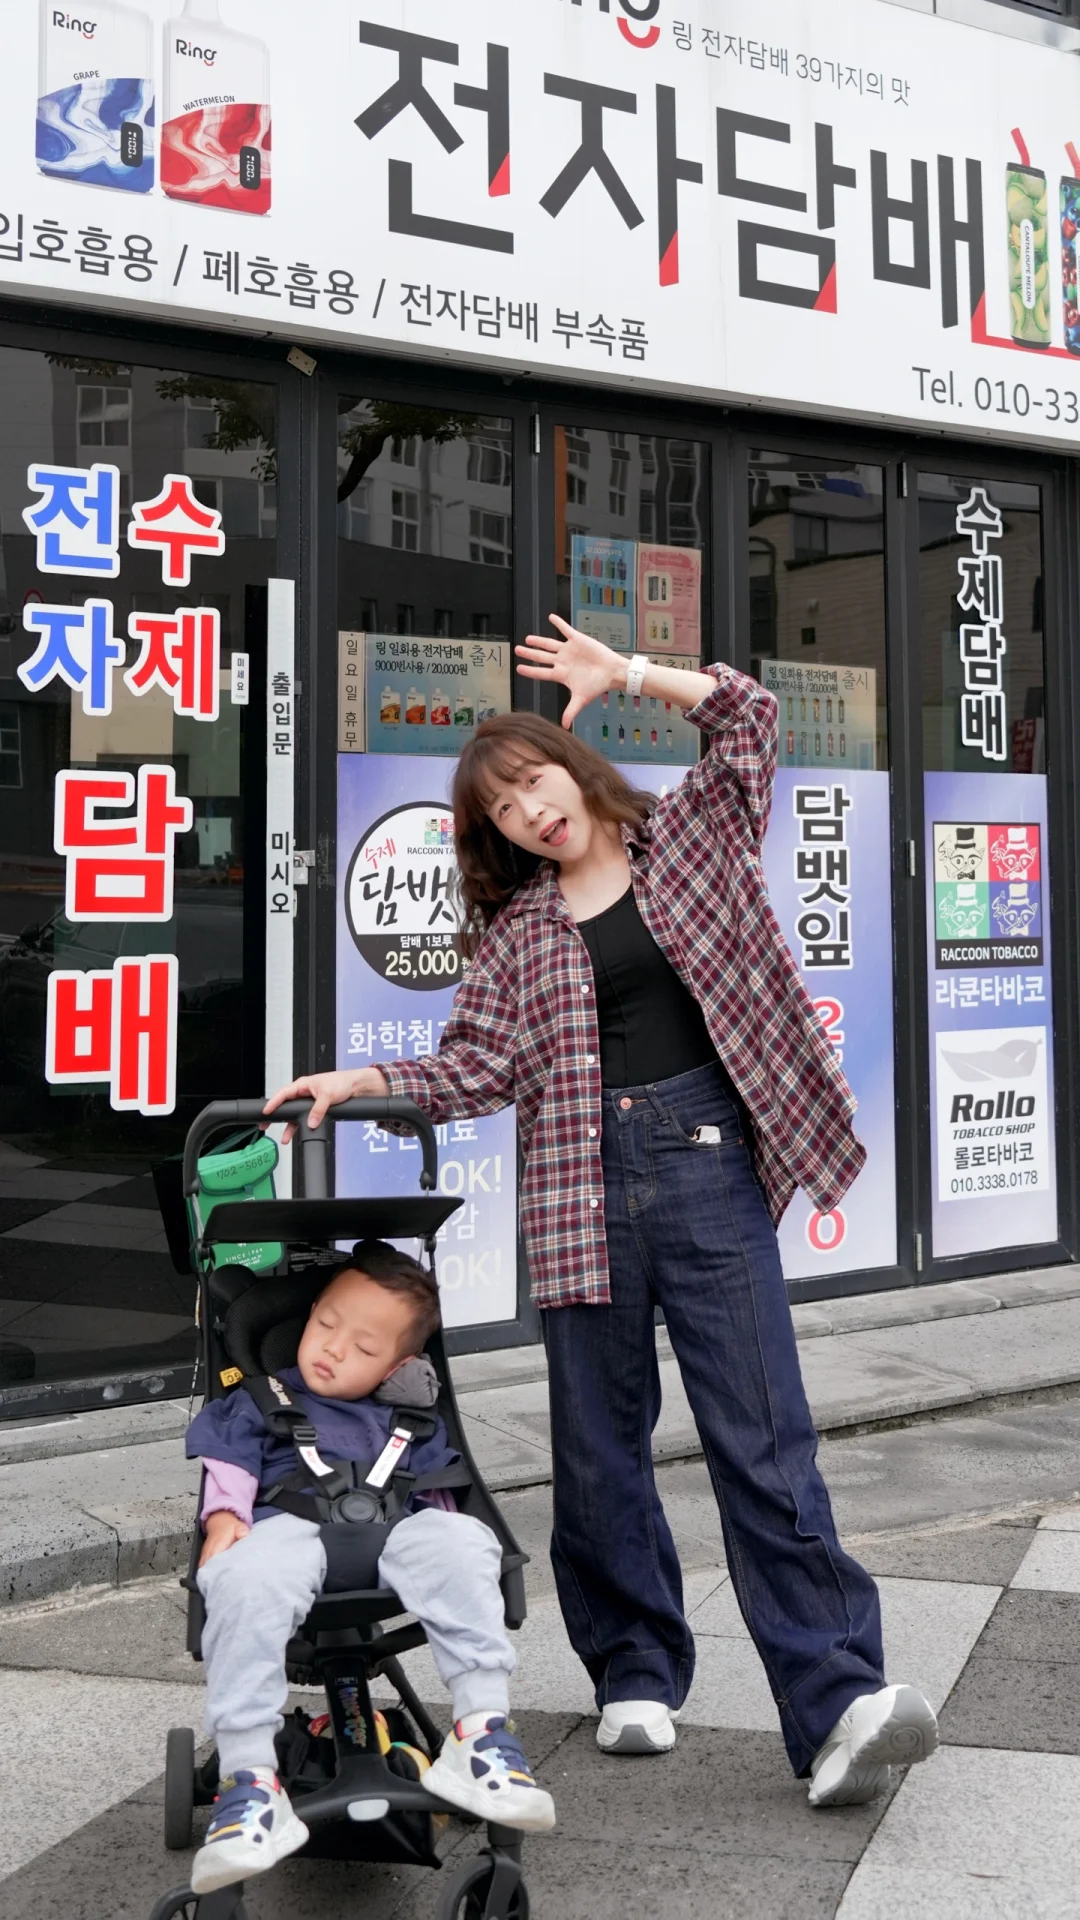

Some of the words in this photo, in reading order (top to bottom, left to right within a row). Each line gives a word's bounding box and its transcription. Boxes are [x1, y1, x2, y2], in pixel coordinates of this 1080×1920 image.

[53, 10, 97, 39] Ring
[176, 38, 217, 67] Ring
[673, 21, 692, 51] 링
[701, 28, 788, 76] 전자담배
[796, 54, 883, 100] 39가지의
[892, 78, 910, 106] 맛
[73, 70, 100, 81] GRAPE
[182, 95, 235, 111] WATERMELON
[354, 20, 986, 343] 전자담배
[0, 213, 158, 282] 입호흡용
[172, 244, 188, 286] /
[202, 250, 359, 315] 폐호흡용
[372, 278, 386, 319] /
[400, 283, 538, 343] 전자담배
[552, 308, 649, 361] 부속품
[912, 366, 963, 407] Tel.
[974, 377, 1079, 424] 010-33
[957, 489, 1005, 758] 수제담배
[375, 660, 425, 674] 9000번사용
[432, 663, 468, 676] 20,000원
[376, 641, 386, 655] 링
[389, 642, 420, 657] 일회용
[423, 643, 463, 660] 전자담배
[470, 645, 502, 667] 출시
[769, 666, 777, 679] 링
[778, 667, 803, 681] 일회용
[805, 669, 837, 682] 전자담배
[842, 670, 868, 690] 출시
[809, 683, 838, 695] 20,000원
[272, 672, 291, 755] 출입문
[365, 838, 396, 869] 수제
[270, 831, 290, 914] 미시오
[795, 785, 851, 968] 담뱃잎
[401, 935, 421, 949] 담배
[426, 934, 453, 948] 1보루
[941, 947, 990, 961] RACCOON
[992, 945, 1038, 959] TOBACCO
[385, 950, 458, 978] 25,000
[935, 975, 1046, 1009] 라쿤타바코
[950, 1090, 1035, 1123] Rollo
[953, 1126, 1003, 1140] TOBACCO
[1005, 1123, 1035, 1135] SHOP
[954, 1142, 1034, 1170] 롤로타바코
[440, 1155, 502, 1196] OK!
[951, 1170, 1038, 1193] 010.3338.0178
[440, 1247, 502, 1290] OK!
